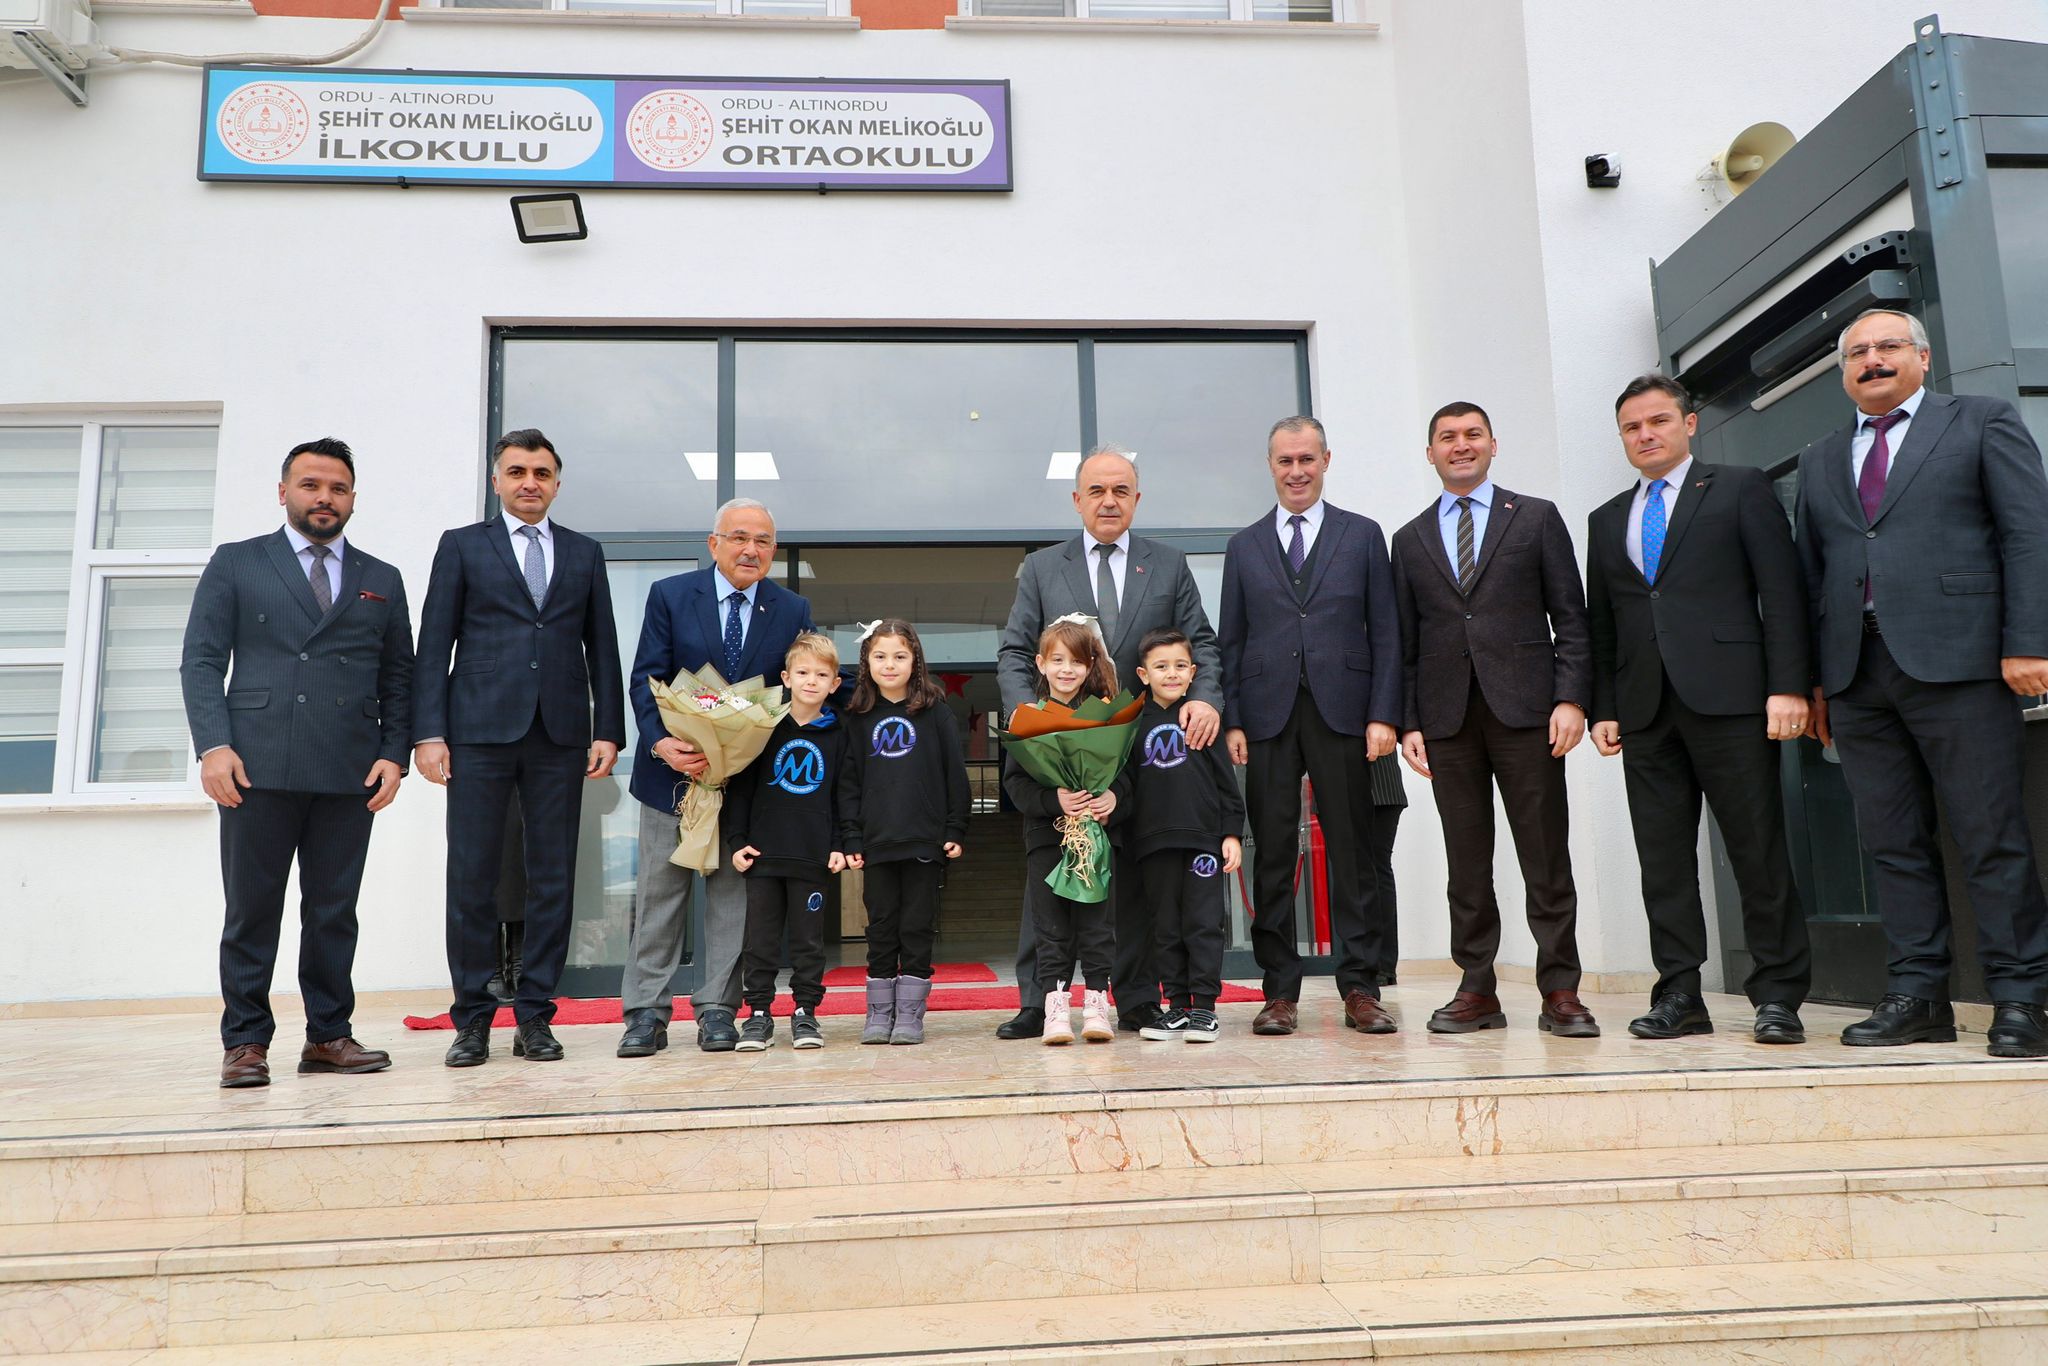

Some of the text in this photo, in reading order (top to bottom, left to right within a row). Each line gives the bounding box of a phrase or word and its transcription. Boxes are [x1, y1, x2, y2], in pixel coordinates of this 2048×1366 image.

[320, 91, 373, 103] ORDU
[390, 93, 495, 106] ALTINORDU
[722, 98, 773, 111] ORDU
[789, 100, 888, 112] ALTINORDU
[319, 108, 593, 132] ŞEHİT OKAN MELİKOĞLU
[722, 115, 983, 137] ŞEHİT OKAN MELİKOĞLU
[319, 133, 548, 163] İLKOKULU
[722, 145, 973, 168] ORTAOKULU
